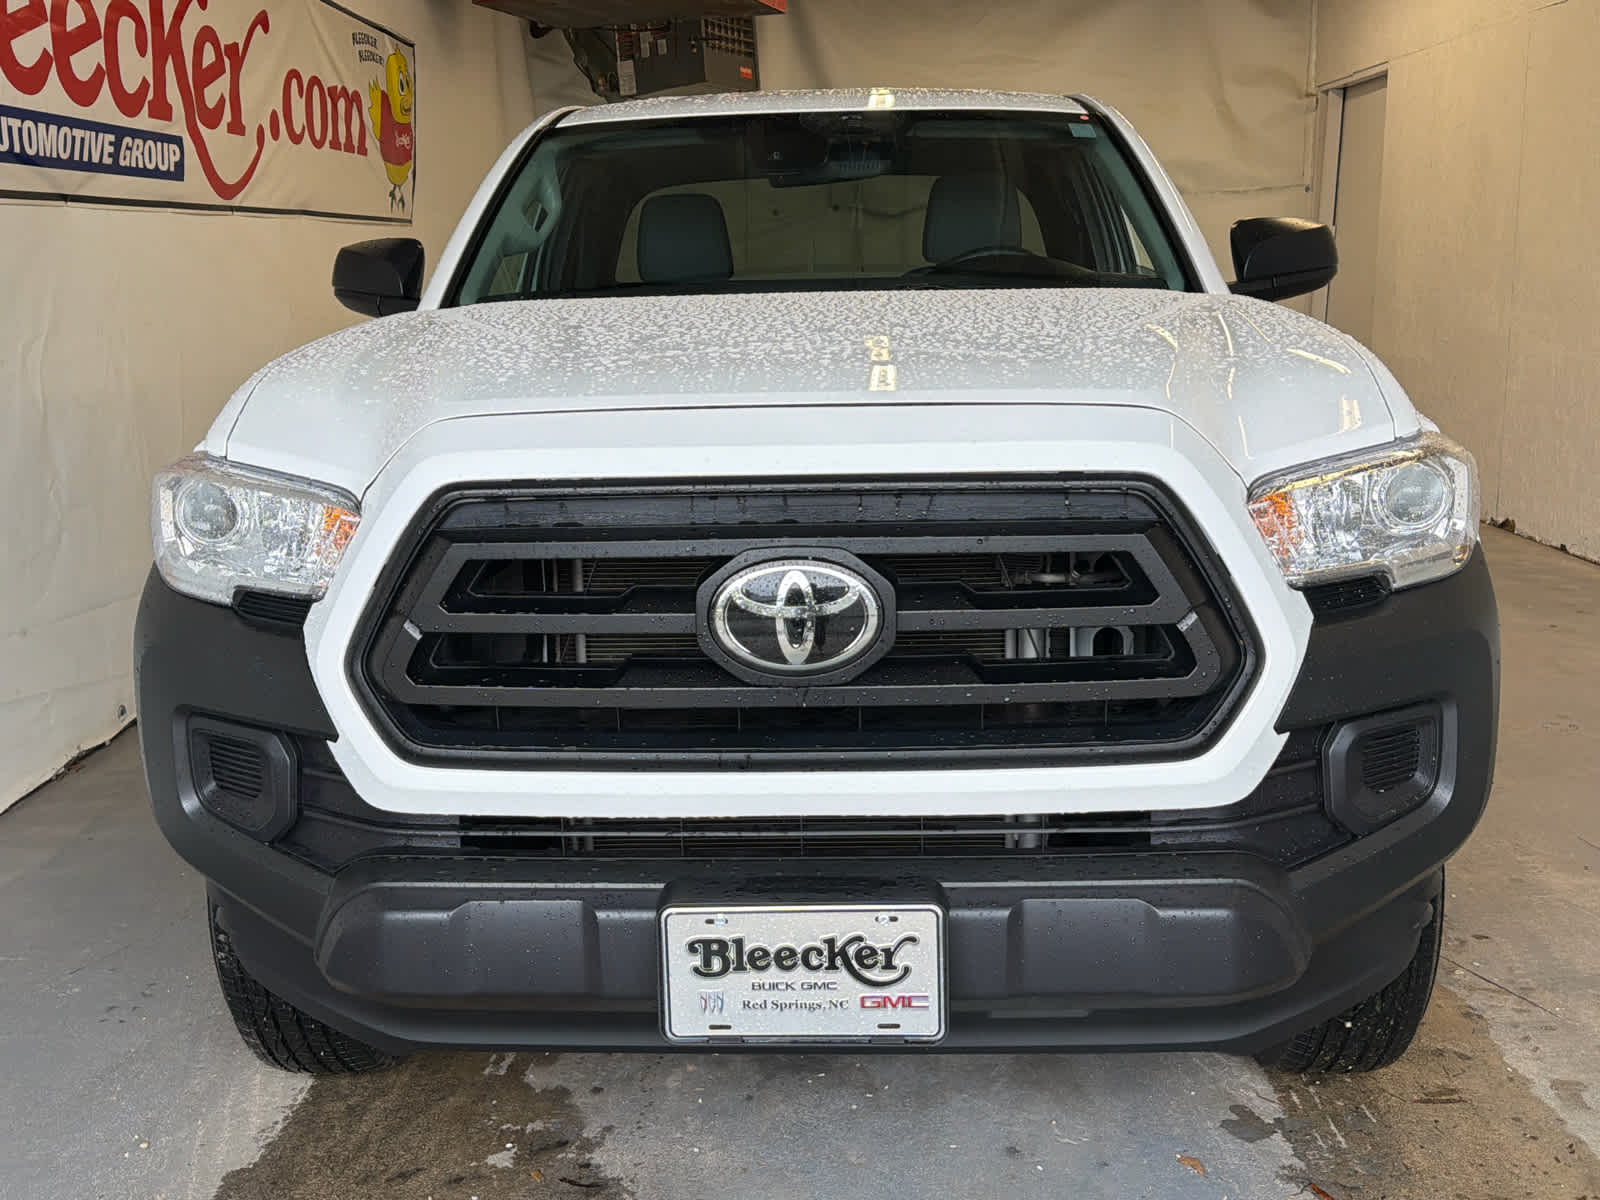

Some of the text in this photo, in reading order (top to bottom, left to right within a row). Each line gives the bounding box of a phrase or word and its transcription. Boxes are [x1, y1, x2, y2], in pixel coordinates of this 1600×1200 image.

[118, 136, 181, 172] GROUP
[687, 934, 919, 987] Bleecker
[751, 981, 838, 992] BUICK GMC
[742, 999, 849, 1013] Red Springs, NC
[860, 994, 929, 1009] GMC
